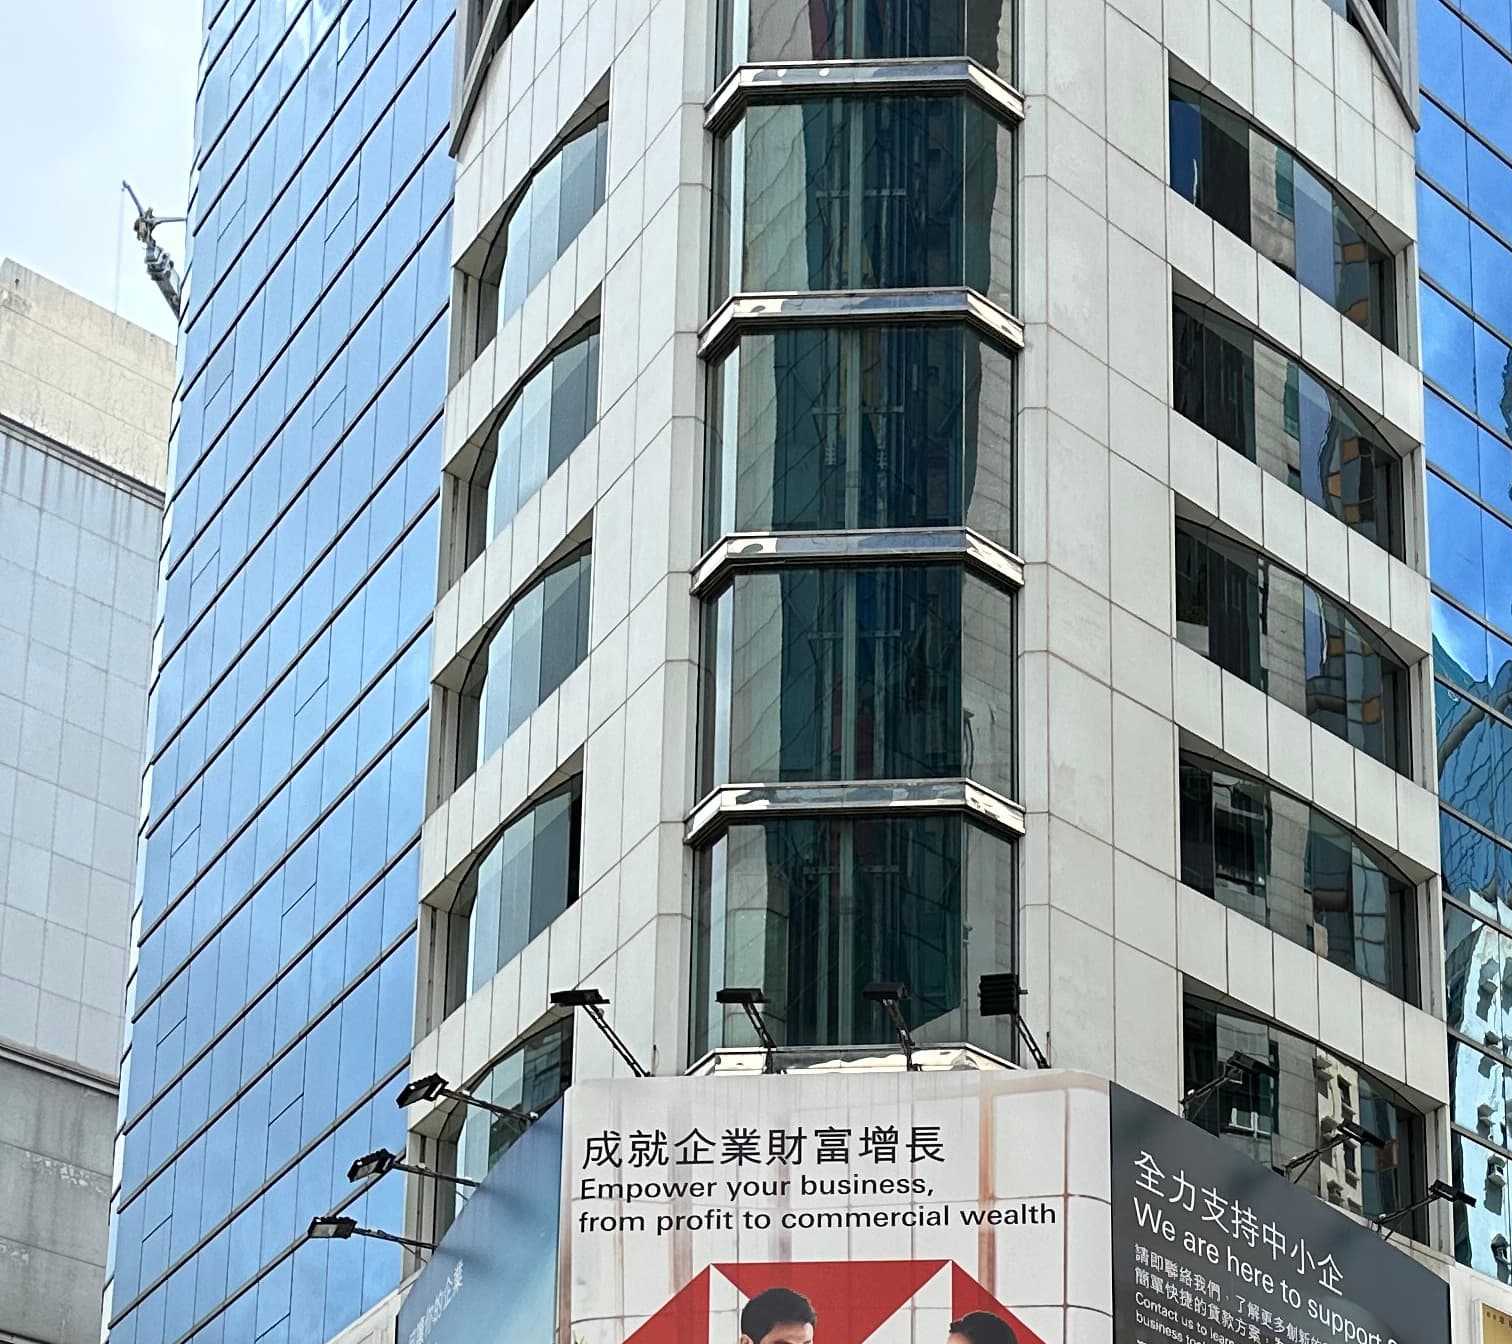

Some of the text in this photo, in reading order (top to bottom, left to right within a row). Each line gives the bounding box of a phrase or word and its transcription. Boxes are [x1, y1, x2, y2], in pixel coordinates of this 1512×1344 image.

[581, 1125, 945, 1170] 成就企業財富增長
[580, 1174, 934, 1203] Empower your business,
[578, 1202, 1057, 1235] from profit to commercial wealth
[1134, 1151, 1344, 1295] 全力支持中小企
[1134, 1198, 1175, 1241] We
[1183, 1231, 1219, 1264] are
[1228, 1246, 1274, 1294] here
[1280, 1280, 1301, 1309] to
